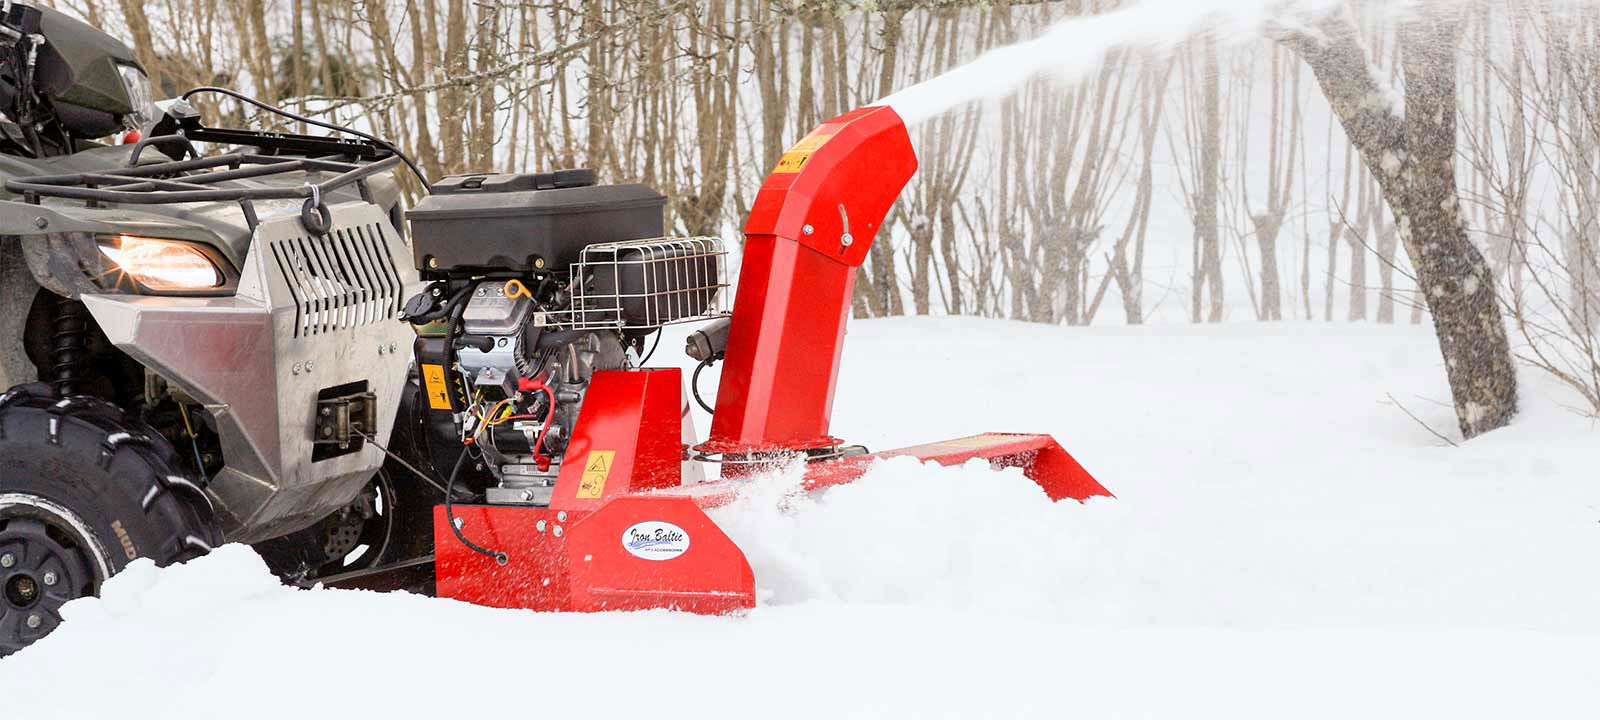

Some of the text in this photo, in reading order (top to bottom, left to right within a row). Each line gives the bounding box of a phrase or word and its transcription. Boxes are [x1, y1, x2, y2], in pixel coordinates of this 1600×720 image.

[111, 519, 136, 560] MUD
[630, 528, 683, 545] Iron Baltic
